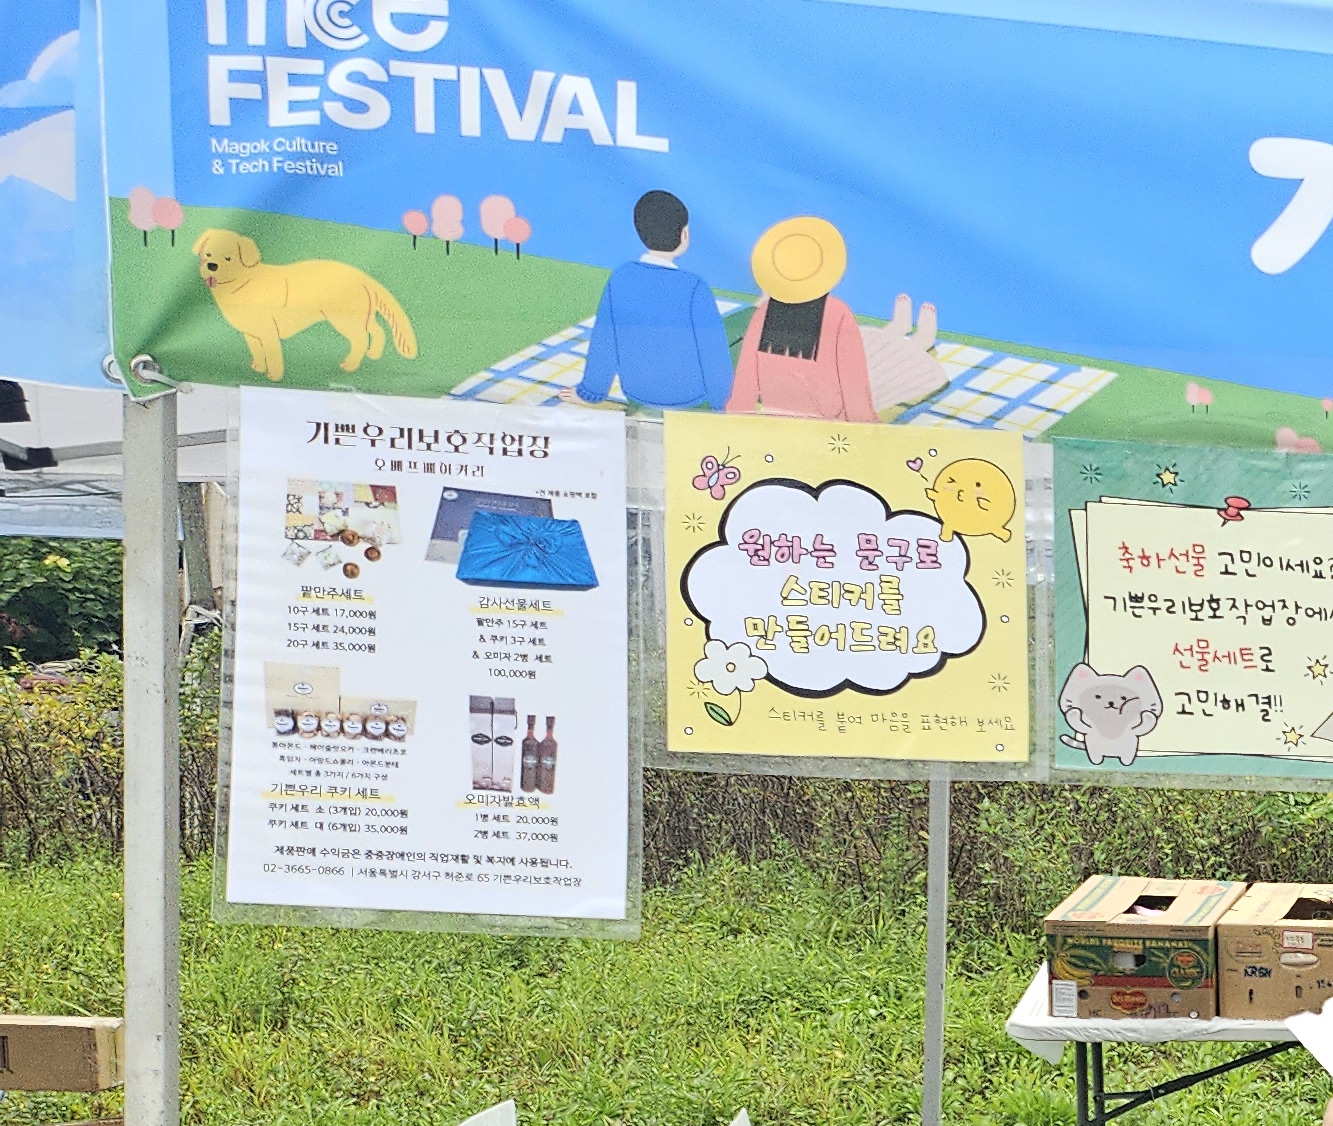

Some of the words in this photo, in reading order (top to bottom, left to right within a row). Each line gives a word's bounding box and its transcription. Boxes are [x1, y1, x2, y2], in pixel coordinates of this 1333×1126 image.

[207, 54, 670, 152] FESTIVAL
[211, 138, 270, 156] Magok
[273, 138, 338, 155] Culture
[212, 159, 225, 175] &
[228, 158, 269, 174] Tech
[273, 157, 343, 177] Festival
[306, 420, 552, 459] 기쁜우리보호작업장
[738, 528, 836, 567] 원하는
[855, 532, 942, 571] 문구로
[1118, 542, 1207, 577] 축하선물
[301, 586, 365, 601] 팥만주세트
[780, 575, 904, 616] 스티커를
[479, 597, 553, 612] 감사선물세트
[288, 606, 308, 616] 10구
[311, 607, 330, 617] 세트
[334, 608, 376, 620] 17,000원
[288, 623, 308, 633] 15구
[311, 624, 330, 633] 세트
[333, 626, 376, 636] 24,000원
[508, 620, 526, 628] 15구
[530, 621, 547, 629] 세트
[528, 638, 546, 646] 세트
[744, 615, 938, 654] 만들어드려요
[287, 639, 308, 648] 20구
[312, 641, 329, 650] 세트
[333, 642, 376, 653] 35,000원
[484, 652, 511, 661] 오미자
[1172, 639, 1276, 673] 선물세트로
[489, 668, 536, 679] 100,000원
[768, 706, 826, 731] 스티커를
[836, 711, 862, 734] 붙여
[871, 711, 912, 734] 마음을
[920, 713, 968, 731] 표현해
[976, 716, 1015, 733] 보세요
[271, 783, 322, 797] 기쁜우리
[326, 786, 351, 799] 쿠키
[355, 788, 381, 799] 세트
[464, 793, 540, 809] 오미자발효액
[268, 803, 287, 812] 쿠키
[290, 803, 309, 813] 세트
[315, 805, 325, 813] 소
[329, 806, 361, 817] (3개입)
[365, 808, 408, 818] 20,000원
[492, 814, 510, 823] 세트
[268, 819, 287, 829] 쿠키
[290, 820, 309, 829] 세트
[315, 822, 324, 831] 대
[328, 822, 361, 833] (6개입)
[365, 824, 408, 835] 35,000원
[492, 830, 510, 839] 세트
[516, 832, 558, 842] 37,000원
[263, 864, 345, 875] 02-3665-0866
[358, 867, 408, 879] 서울특별시
[411, 869, 441, 880] 강서구
[477, 874, 489, 882] 65
[493, 874, 582, 887] 기쁜우리보호작업장
